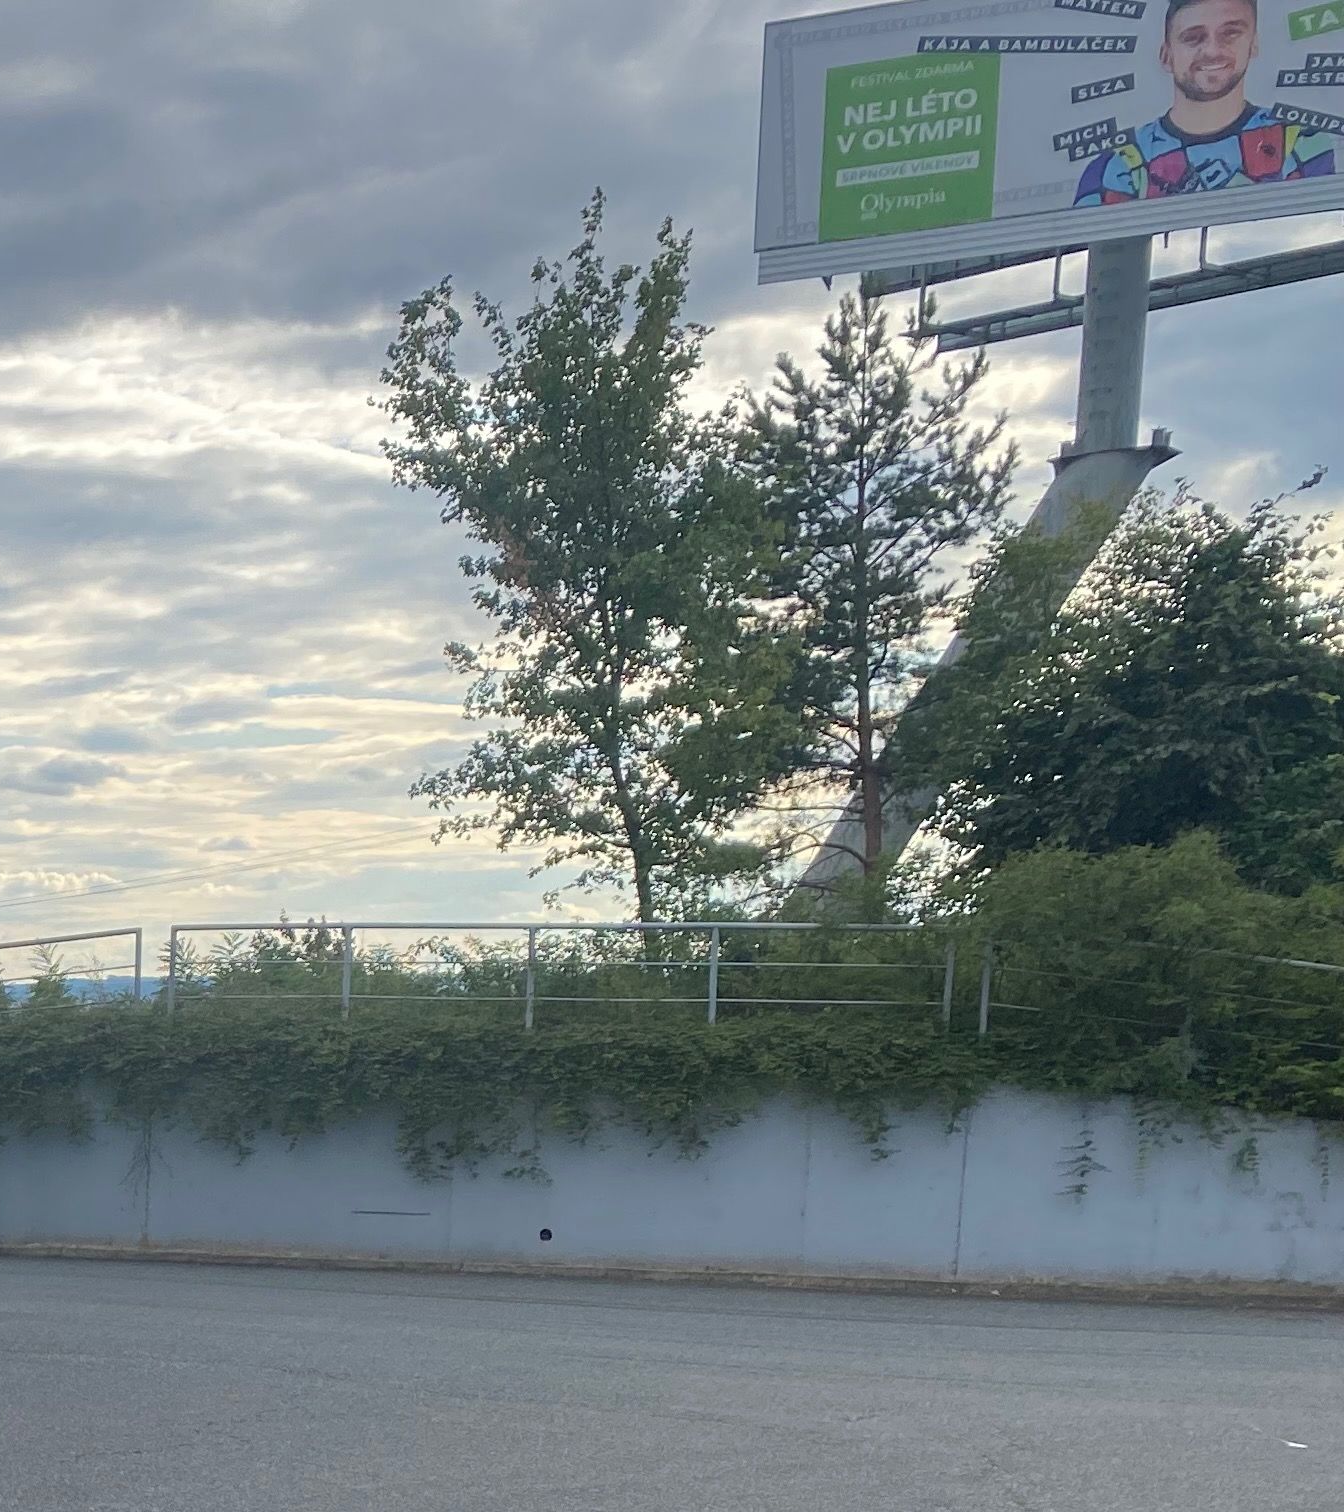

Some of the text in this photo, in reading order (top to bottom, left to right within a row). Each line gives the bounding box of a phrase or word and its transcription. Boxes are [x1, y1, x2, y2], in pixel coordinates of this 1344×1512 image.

[923, 36, 1128, 50] KÁJA A BAMBULÁČEK
[851, 60, 975, 89] FESTIVAL ZDARMA
[1078, 79, 1127, 100] SLZA
[844, 88, 978, 126] NEJ LÉTO
[837, 114, 983, 155] V OLYMPII
[1059, 123, 1109, 148] MICH
[1075, 133, 1128, 158] SAKO
[842, 155, 974, 184] SRPNOVÉ VÍKENDY
[862, 187, 947, 213] Olympia
